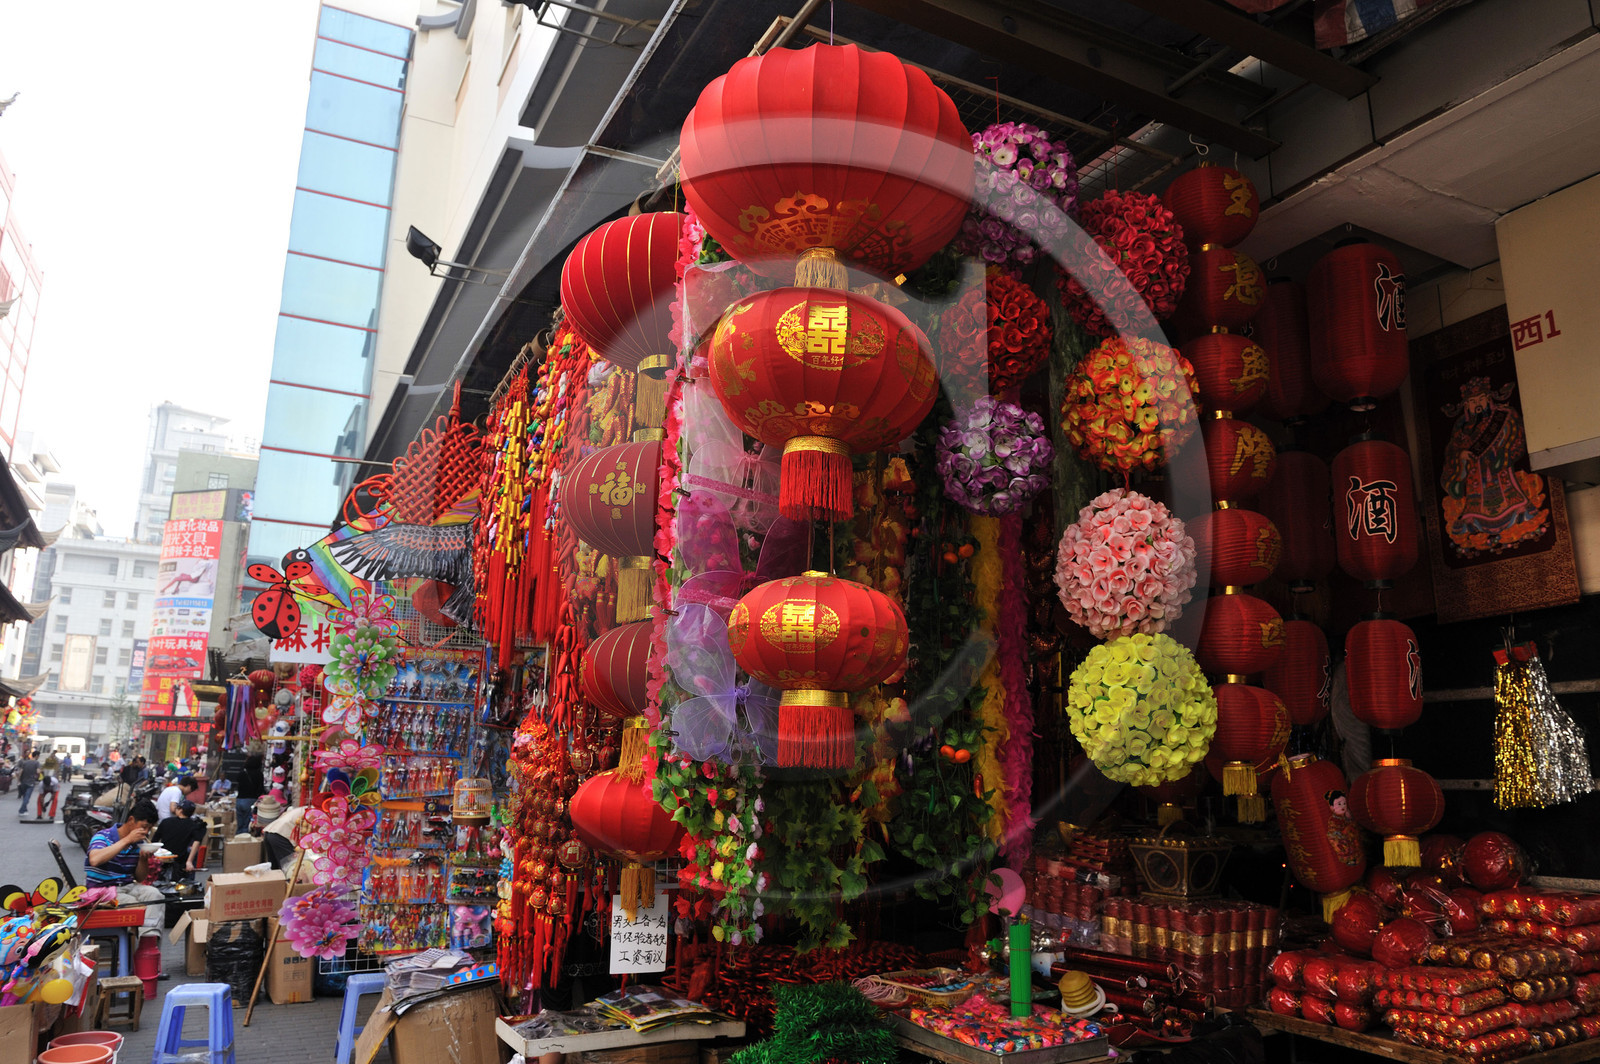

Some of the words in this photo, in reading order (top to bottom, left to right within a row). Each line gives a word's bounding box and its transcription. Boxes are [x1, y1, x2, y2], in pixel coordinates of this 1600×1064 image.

[1510, 309, 1562, 352] 西1
[599, 471, 633, 506] 福
[1346, 476, 1397, 543] 酒
[782, 603, 815, 643] 囍
